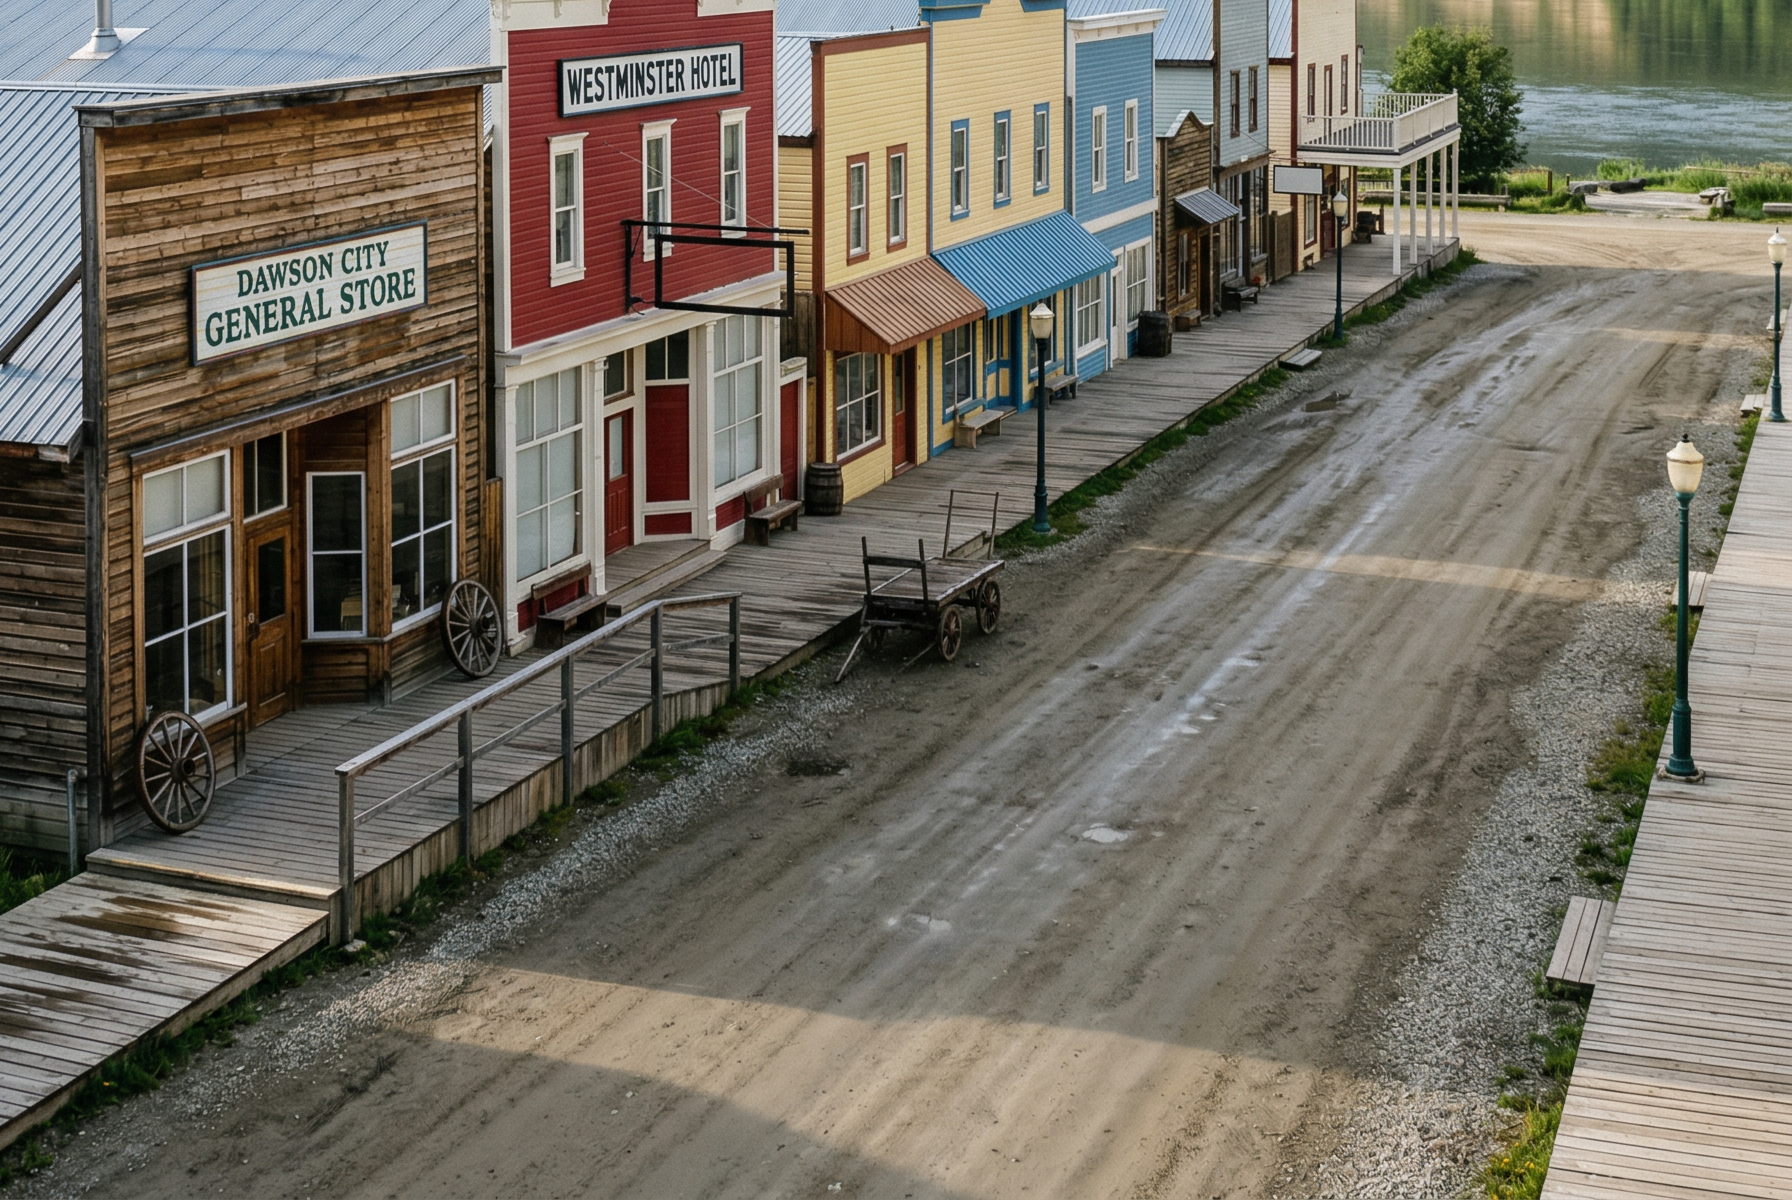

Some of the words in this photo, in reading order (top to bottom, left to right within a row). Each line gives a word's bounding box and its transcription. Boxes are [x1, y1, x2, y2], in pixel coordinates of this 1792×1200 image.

[567, 58, 685, 105] WESTMINSTER
[691, 53, 736, 90] HOTEL
[237, 252, 333, 298] DAWSON
[341, 240, 389, 274] CITY
[205, 288, 332, 347] GENERAL
[340, 268, 416, 314] STORE
